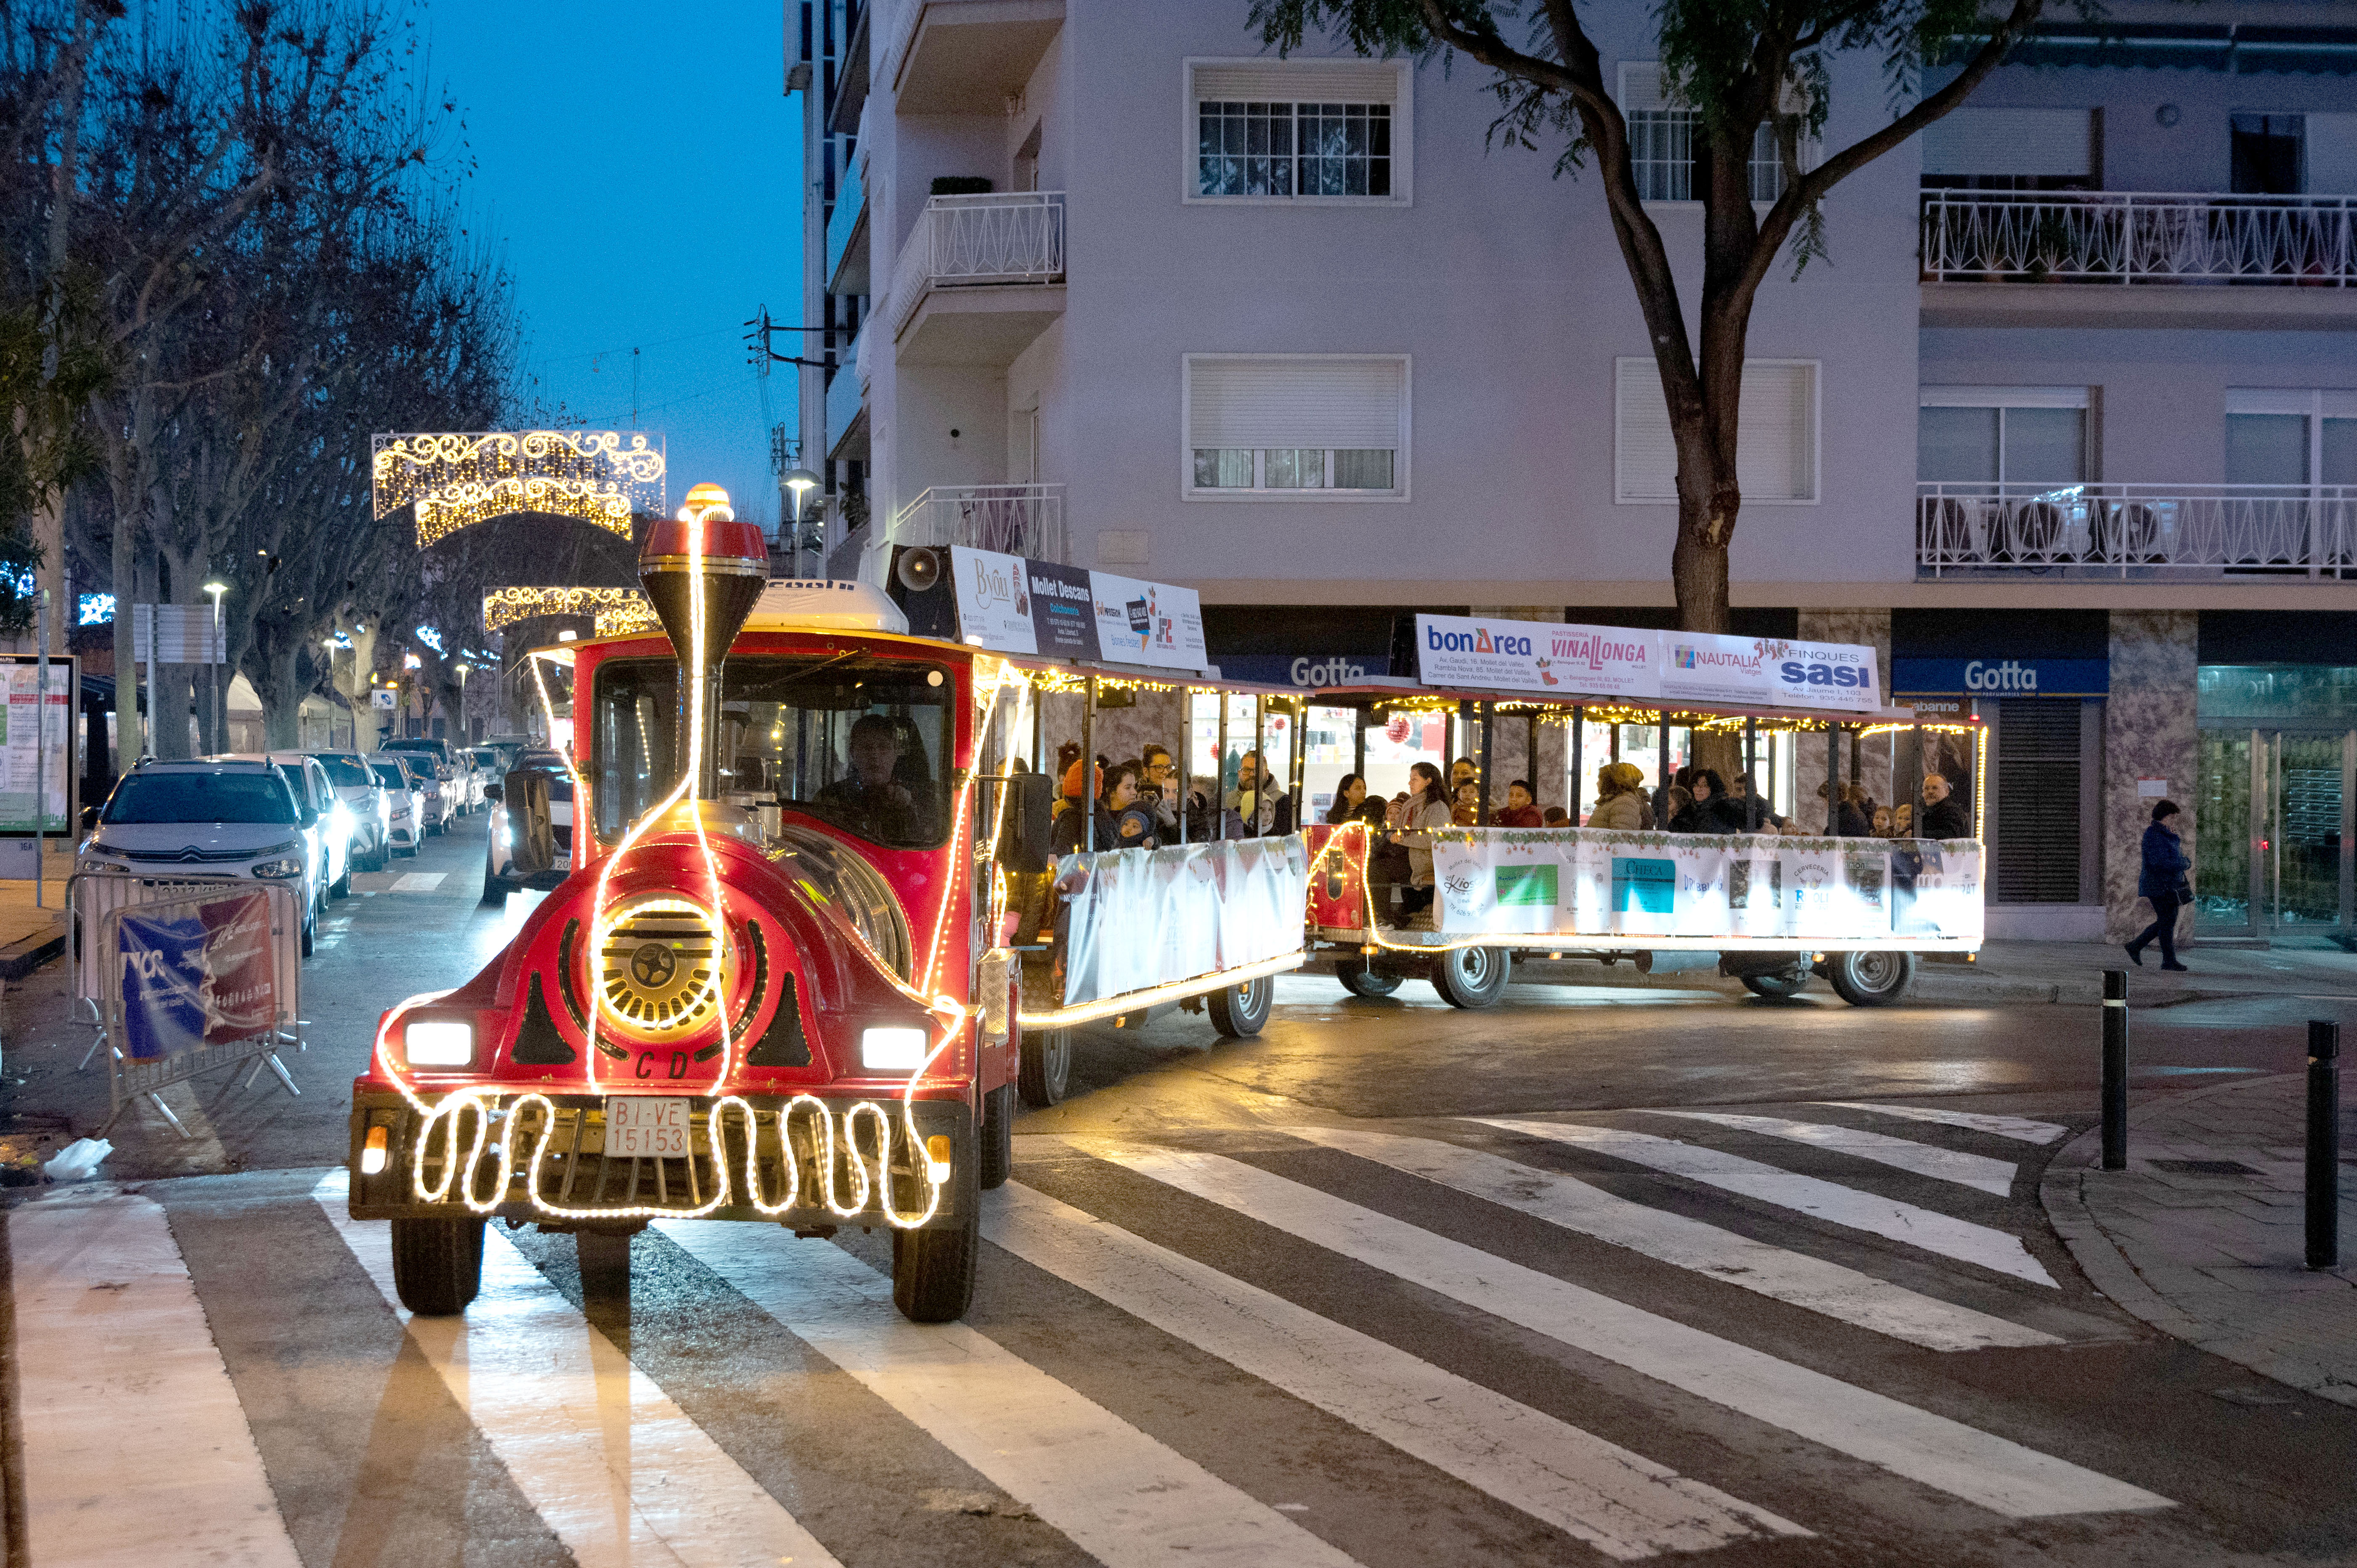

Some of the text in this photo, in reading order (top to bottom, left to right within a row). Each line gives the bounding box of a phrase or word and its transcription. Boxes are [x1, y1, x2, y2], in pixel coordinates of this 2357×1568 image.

[1031, 576, 1090, 601] Mollet Descans
[1697, 652, 1761, 669] NAUTALIA
[1789, 649, 1859, 662] FINQUES
[1740, 667, 1762, 676] Viatges
[1965, 660, 2038, 691] Gotta
[557, 860, 571, 869] 20
[1625, 861, 1662, 875] CHECA
[1794, 864, 1829, 877] CERVECERIA
[1795, 890, 1829, 903] RIOLI
[615, 1128, 683, 1152] 15153
